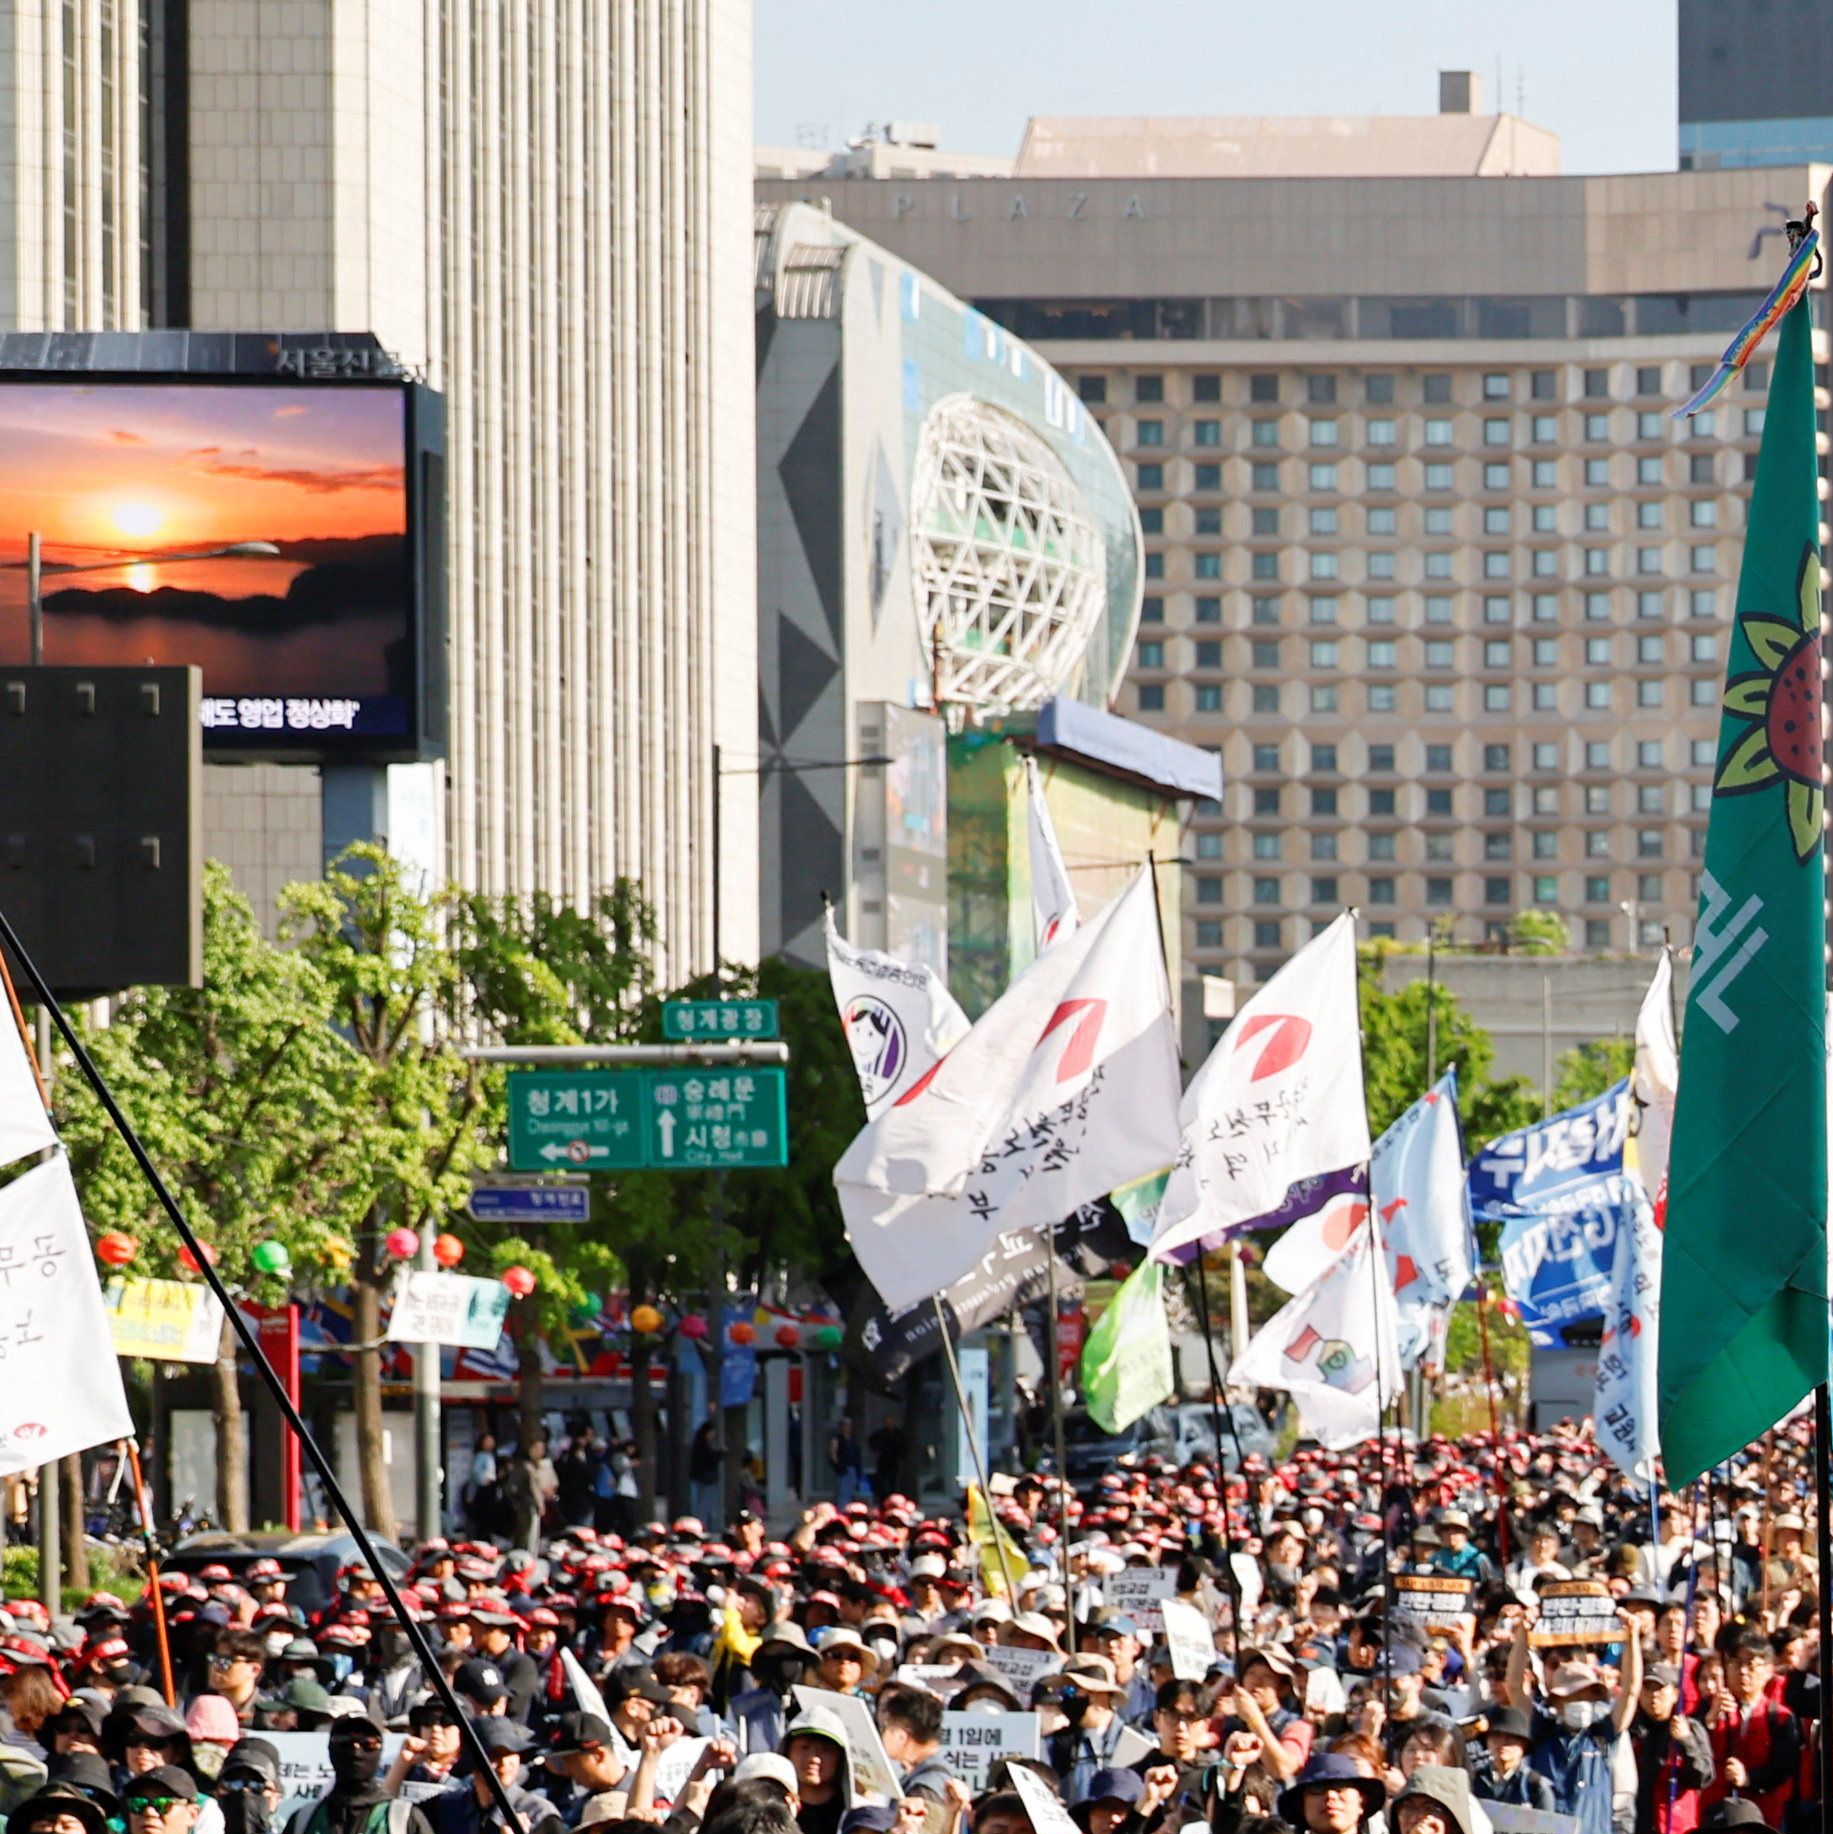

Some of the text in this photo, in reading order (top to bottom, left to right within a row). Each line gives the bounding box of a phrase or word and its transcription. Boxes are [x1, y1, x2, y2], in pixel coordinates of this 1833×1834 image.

[891, 194, 1147, 221] PLAZA
[237, 698, 284, 729] 영업
[676, 1008, 763, 1032] 청계광장
[527, 1088, 618, 1116] 청계1가
[684, 1076, 755, 1102] 숭례문
[685, 1125, 731, 1151] 시청
